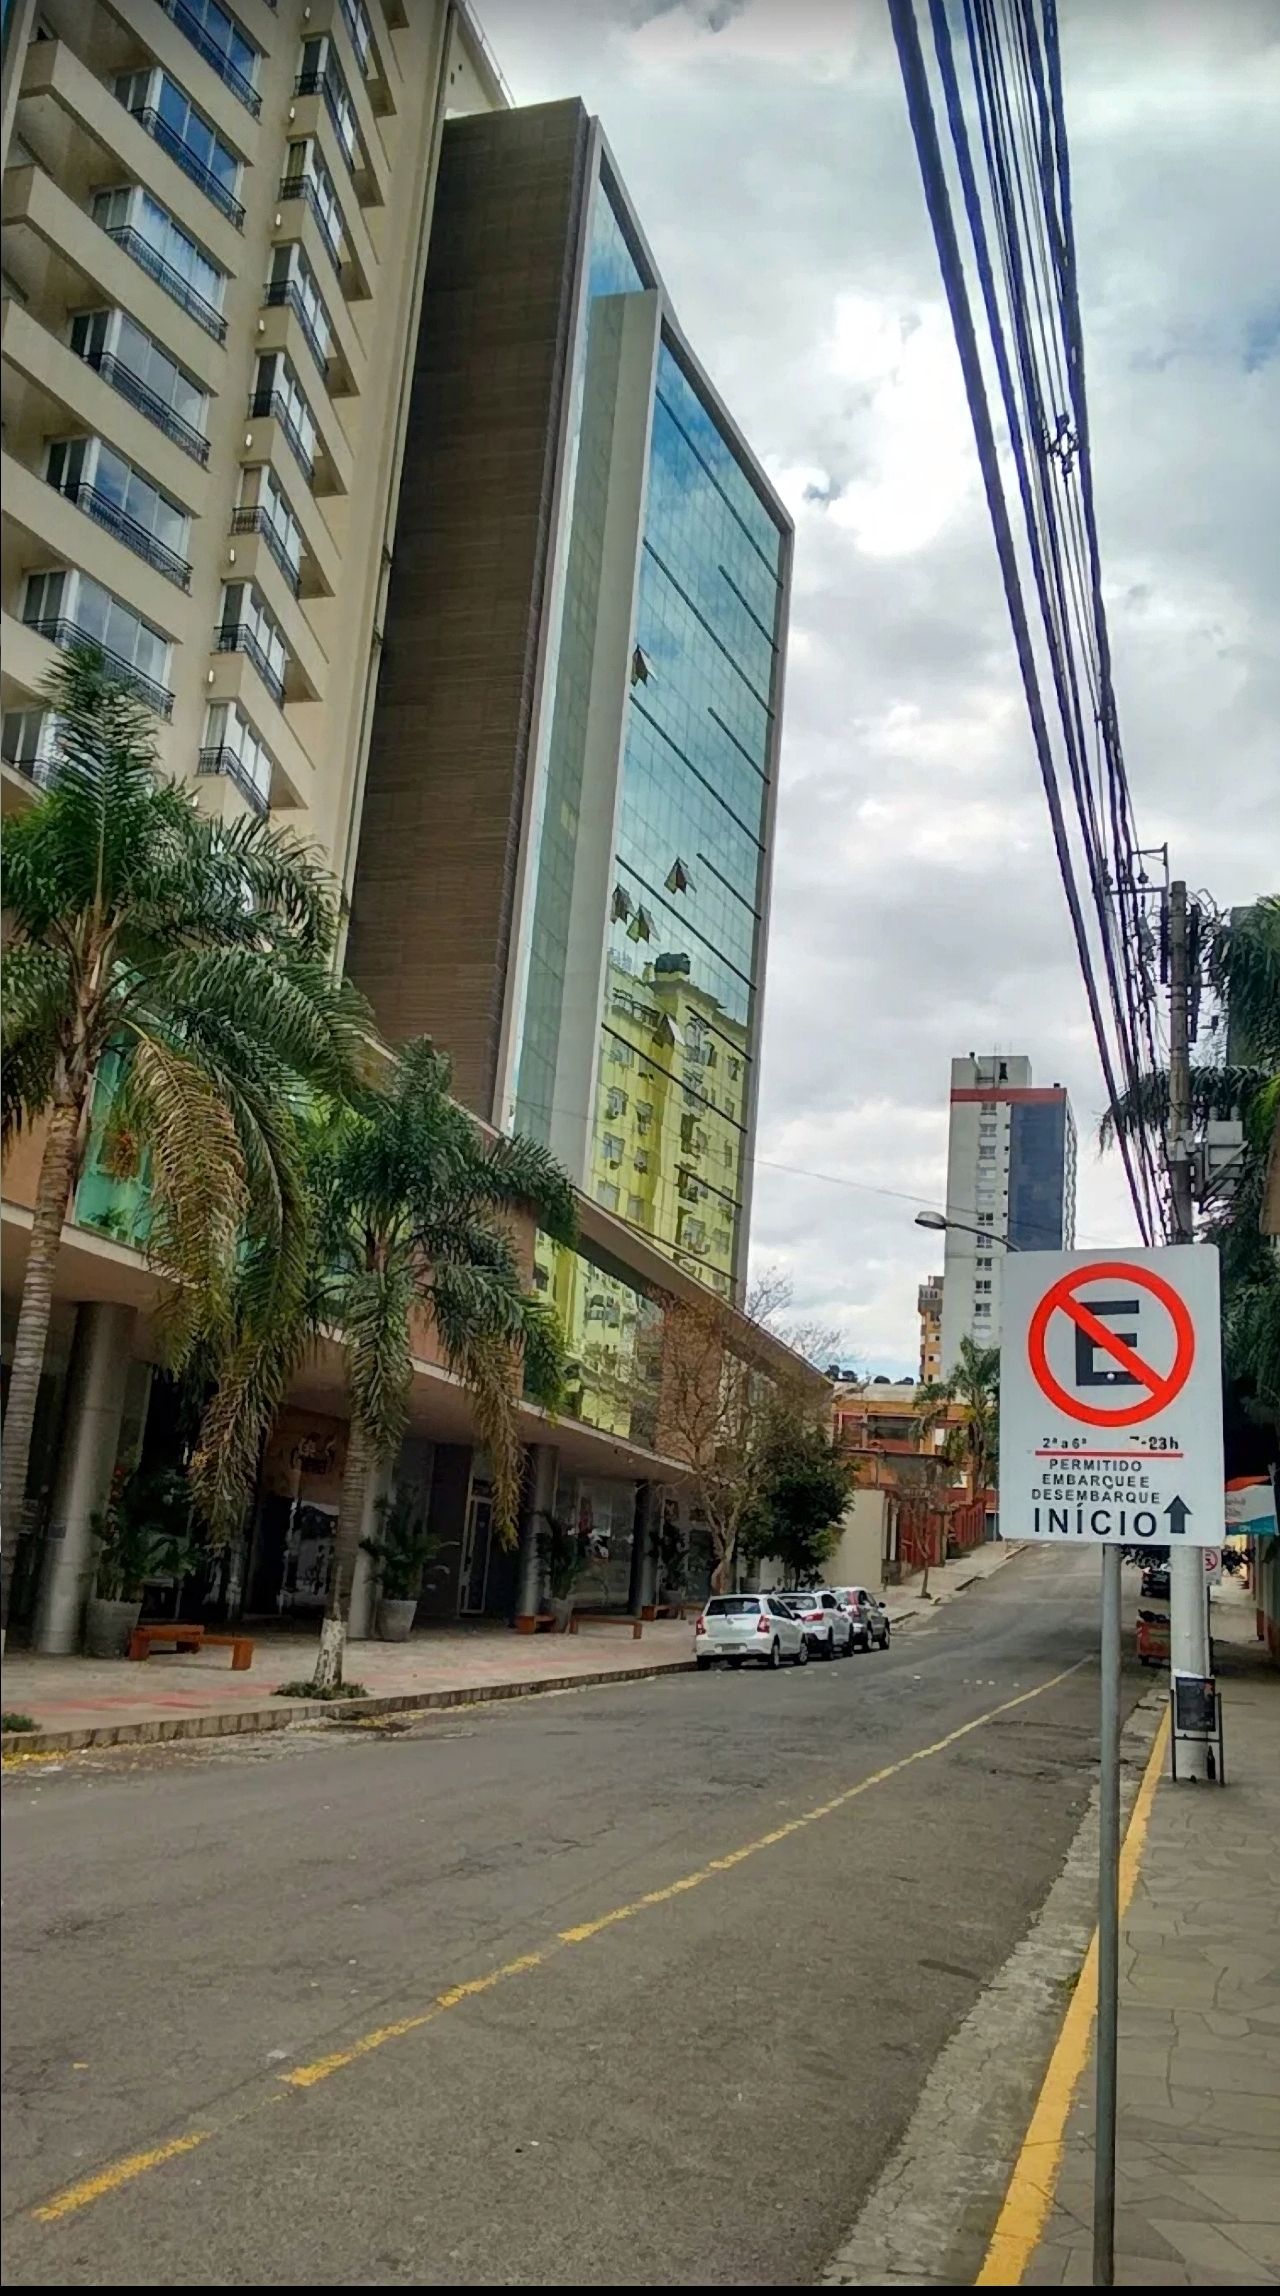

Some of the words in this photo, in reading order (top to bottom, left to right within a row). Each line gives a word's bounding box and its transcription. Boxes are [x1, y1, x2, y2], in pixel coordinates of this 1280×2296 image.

[1049, 1458, 1142, 1472] PERMITIDO
[1031, 1488, 1160, 1504] DESEMBARQUE
[1034, 1502, 1157, 1538] INÍCIO
